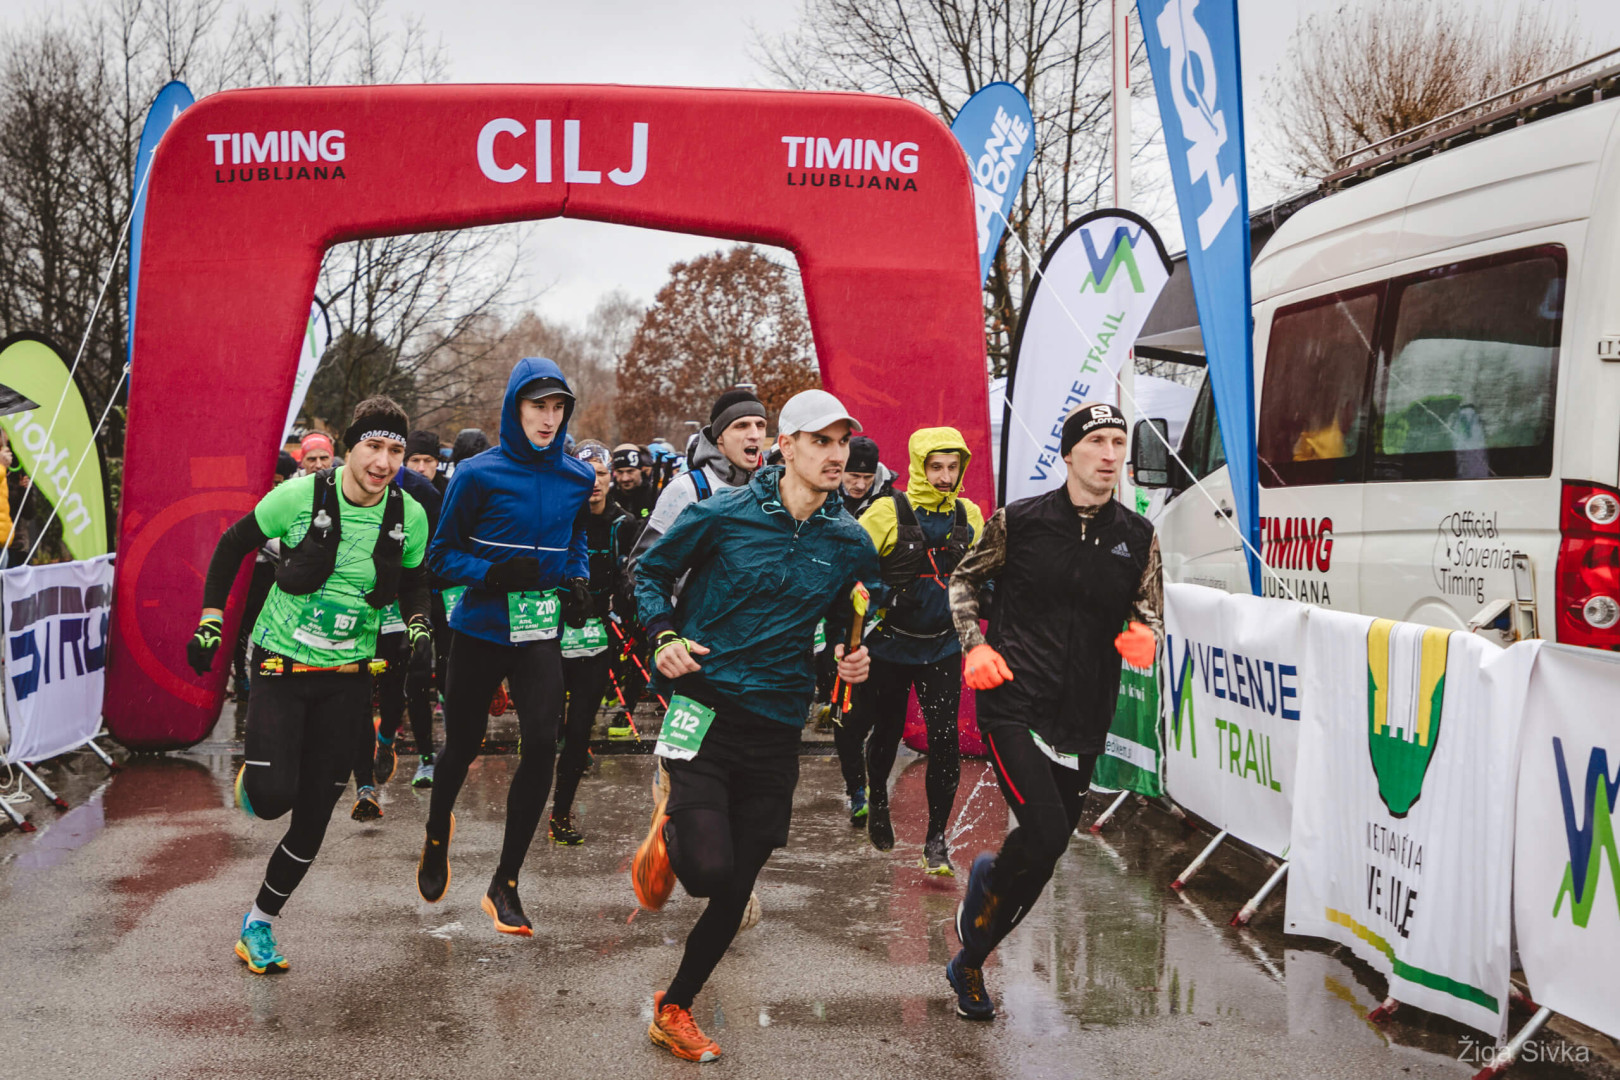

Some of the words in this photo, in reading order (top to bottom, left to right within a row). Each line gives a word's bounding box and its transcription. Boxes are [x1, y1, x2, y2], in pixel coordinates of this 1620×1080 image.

[206, 129, 346, 165] TIMING
[477, 118, 649, 186] CILJ
[781, 136, 919, 174] TIMING
[977, 105, 1013, 186] ONE
[992, 114, 1030, 195] ONE
[215, 165, 346, 183] LJUBLJANA
[787, 172, 918, 192] LJUBLJANA
[1079, 310, 1126, 374] TRAIL
[1082, 417, 1125, 431] salomon
[1451, 511, 1499, 539] Official
[1440, 568, 1485, 604] Timing
[334, 613, 358, 630] 151
[536, 599, 556, 616] 210
[1198, 642, 1301, 721] VELENJE
[670, 709, 700, 734] 212
[1215, 717, 1282, 793] TRAIL
